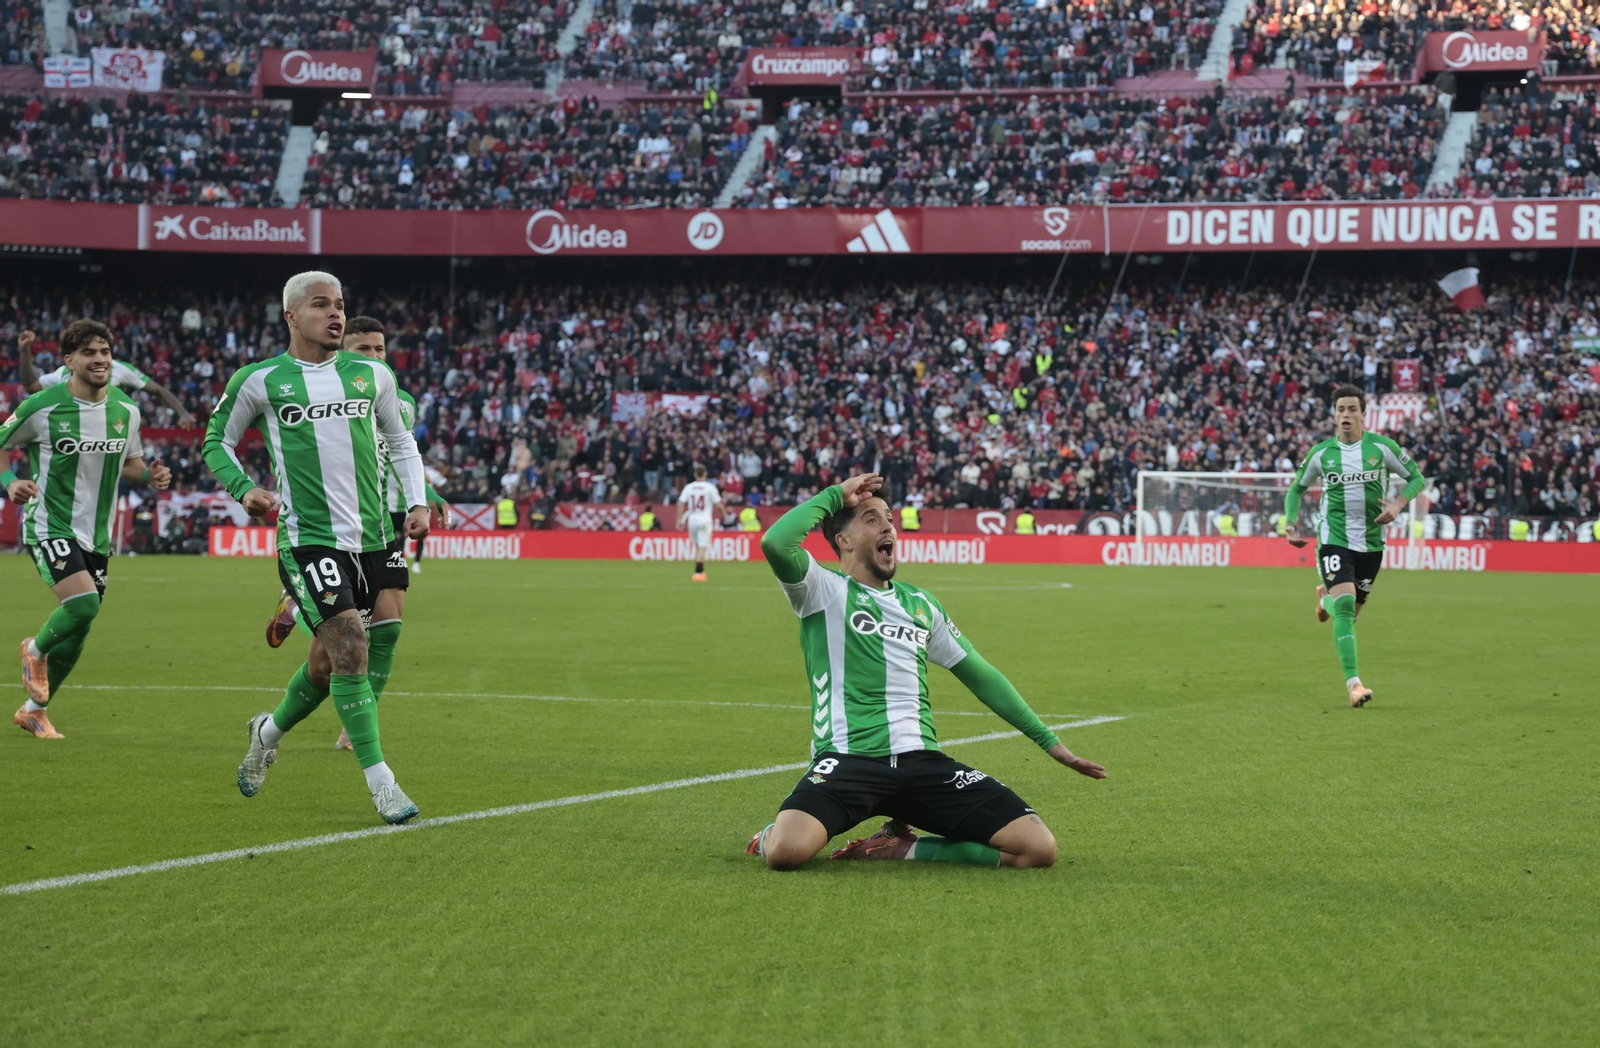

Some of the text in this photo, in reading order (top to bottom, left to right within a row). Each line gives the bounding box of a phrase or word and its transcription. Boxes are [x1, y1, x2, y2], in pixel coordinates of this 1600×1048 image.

[752, 54, 850, 77] Cruzcampo
[1455, 42, 1528, 66] Midea
[293, 60, 362, 83] Midea
[188, 215, 306, 242] CaixaBank
[541, 222, 628, 251] Midea
[694, 222, 717, 239] JD
[1167, 209, 1275, 245] DICEN
[1287, 208, 1360, 248] QUE
[1371, 205, 1500, 242] NUNCA
[1511, 204, 1558, 241] SE
[1021, 239, 1092, 250] socios.com
[307, 401, 369, 420] GREE
[79, 439, 126, 452] GREE
[1341, 470, 1380, 482] GREE
[690, 494, 705, 511] 14
[41, 538, 71, 562] 10
[214, 529, 277, 556] LALI
[897, 537, 985, 564] UNAMBÚ
[305, 557, 341, 592] 19
[1323, 554, 1341, 573] 16
[879, 623, 928, 646] GRE
[342, 698, 373, 710] BETIS
[813, 757, 839, 775] 8
